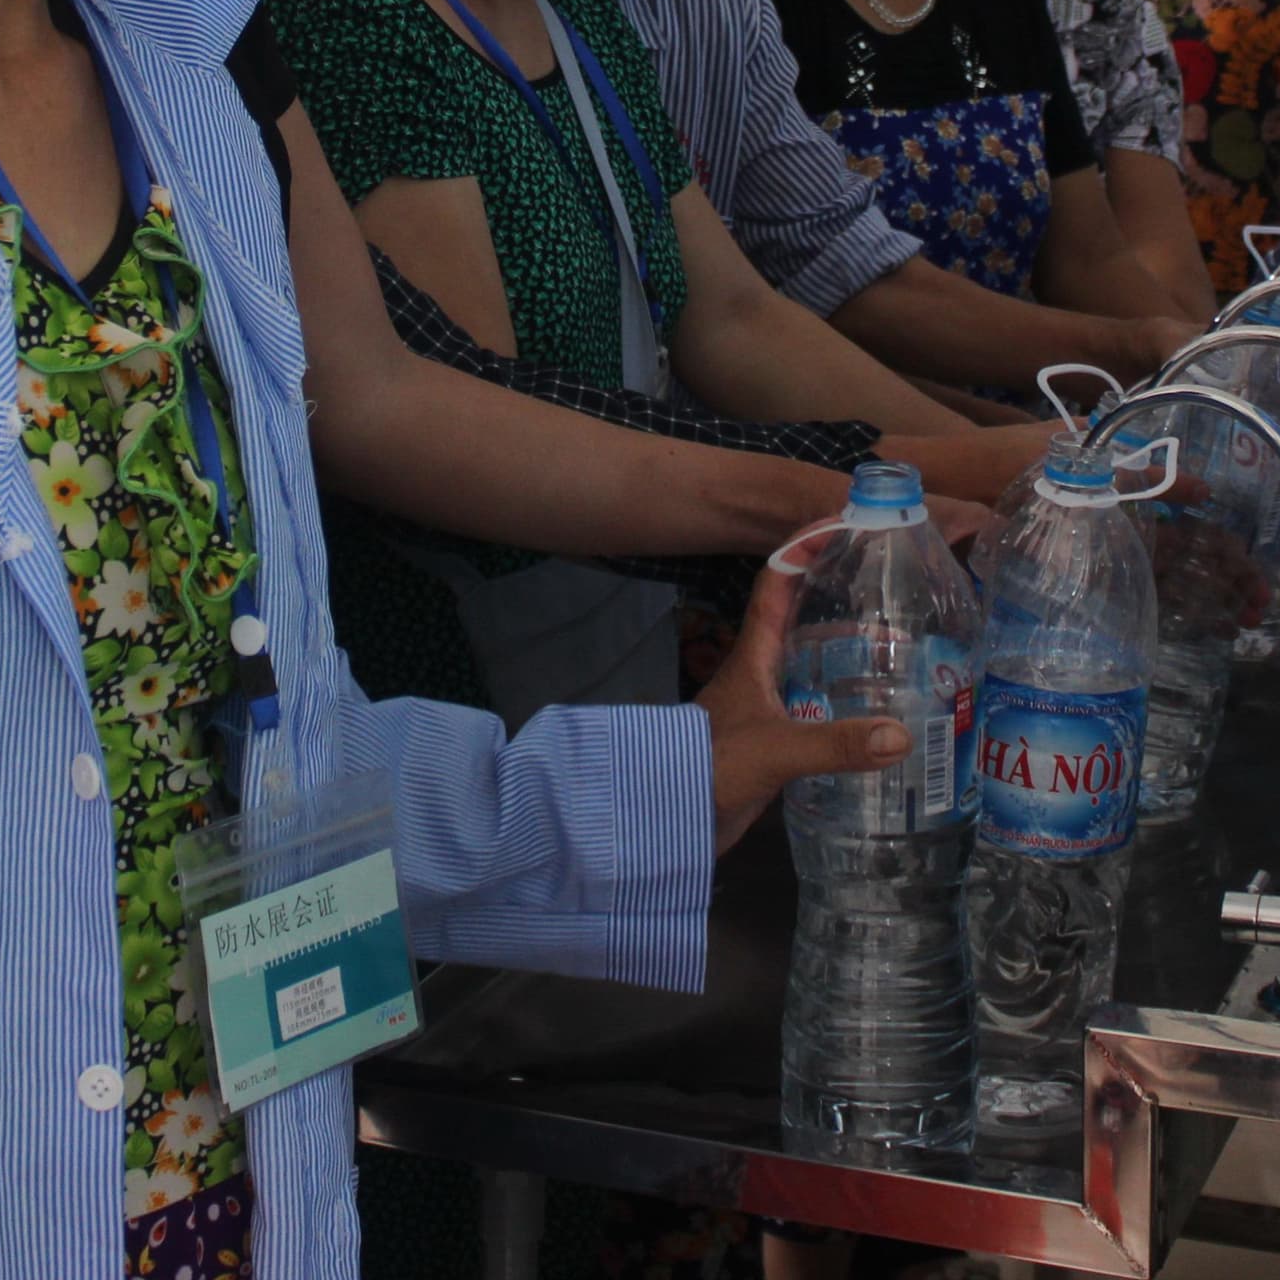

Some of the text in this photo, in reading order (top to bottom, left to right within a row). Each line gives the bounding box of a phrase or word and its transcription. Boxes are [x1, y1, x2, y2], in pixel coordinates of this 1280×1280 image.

[981, 735, 1035, 790] HÀ
[1048, 743, 1124, 807] NỘI
[214, 883, 340, 960] 防水展会证
